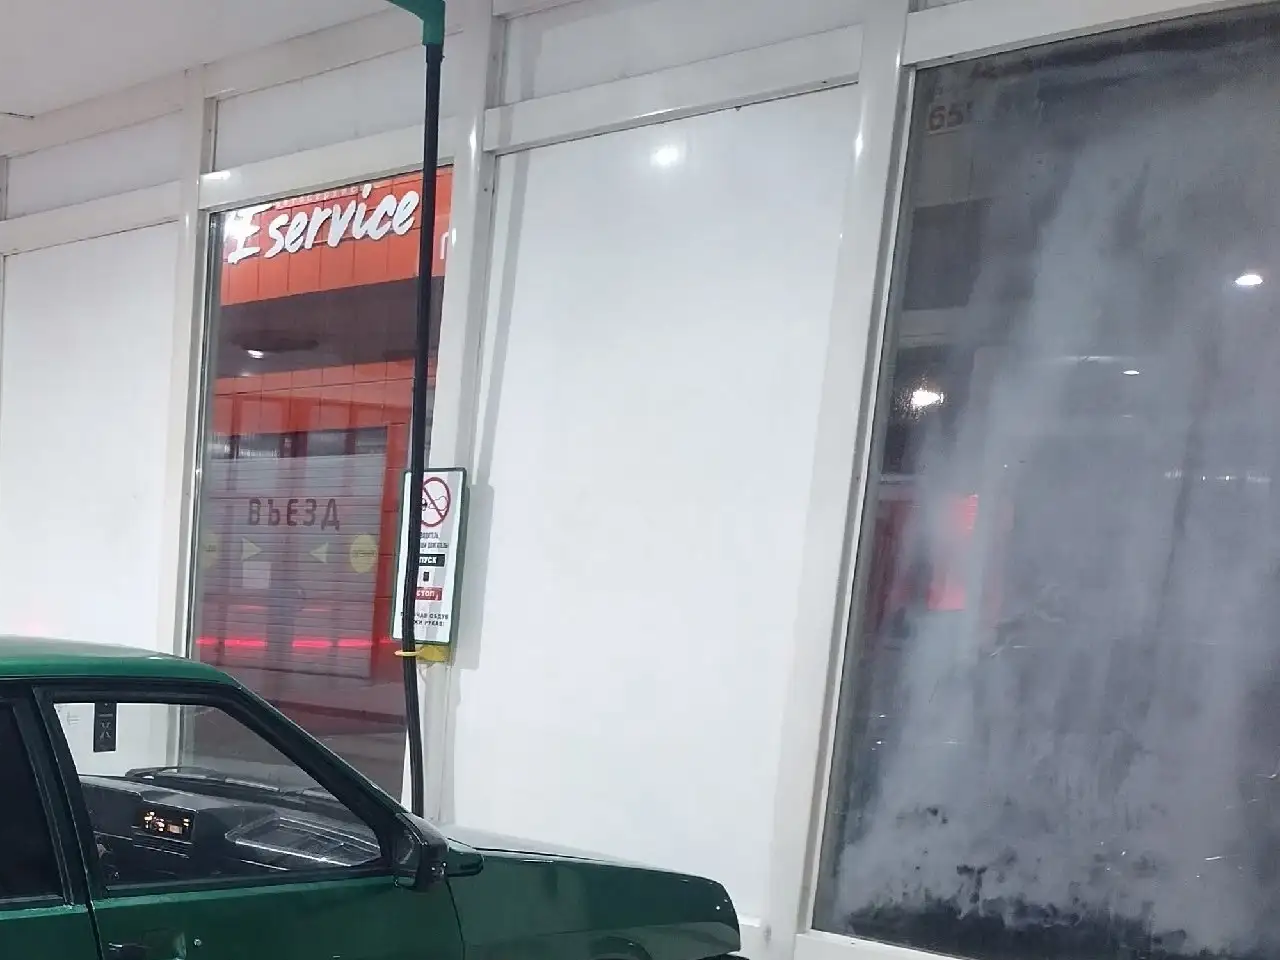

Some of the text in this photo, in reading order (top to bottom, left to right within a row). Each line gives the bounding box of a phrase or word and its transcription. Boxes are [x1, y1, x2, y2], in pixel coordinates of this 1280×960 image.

[263, 184, 420, 258] service
[248, 498, 340, 531] ВЪЕЗД
[418, 556, 437, 564] ПУСК
